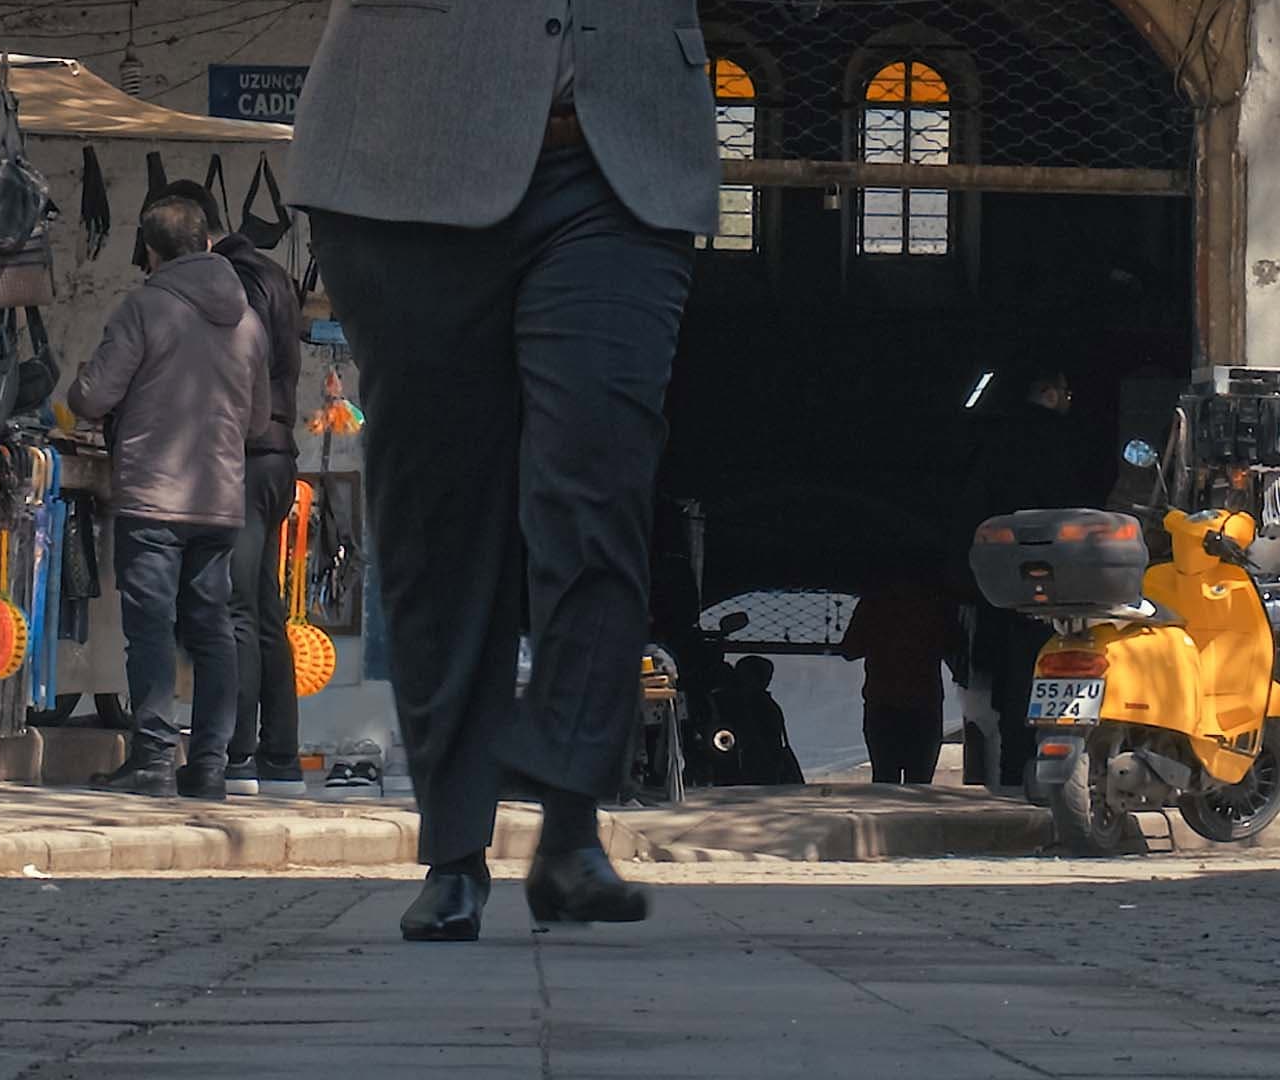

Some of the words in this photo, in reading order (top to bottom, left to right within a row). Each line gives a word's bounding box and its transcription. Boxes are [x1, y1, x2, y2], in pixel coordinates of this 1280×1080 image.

[1036, 682, 1059, 699] 55
[1063, 683, 1100, 699] ALU
[1045, 701, 1080, 717] 224
